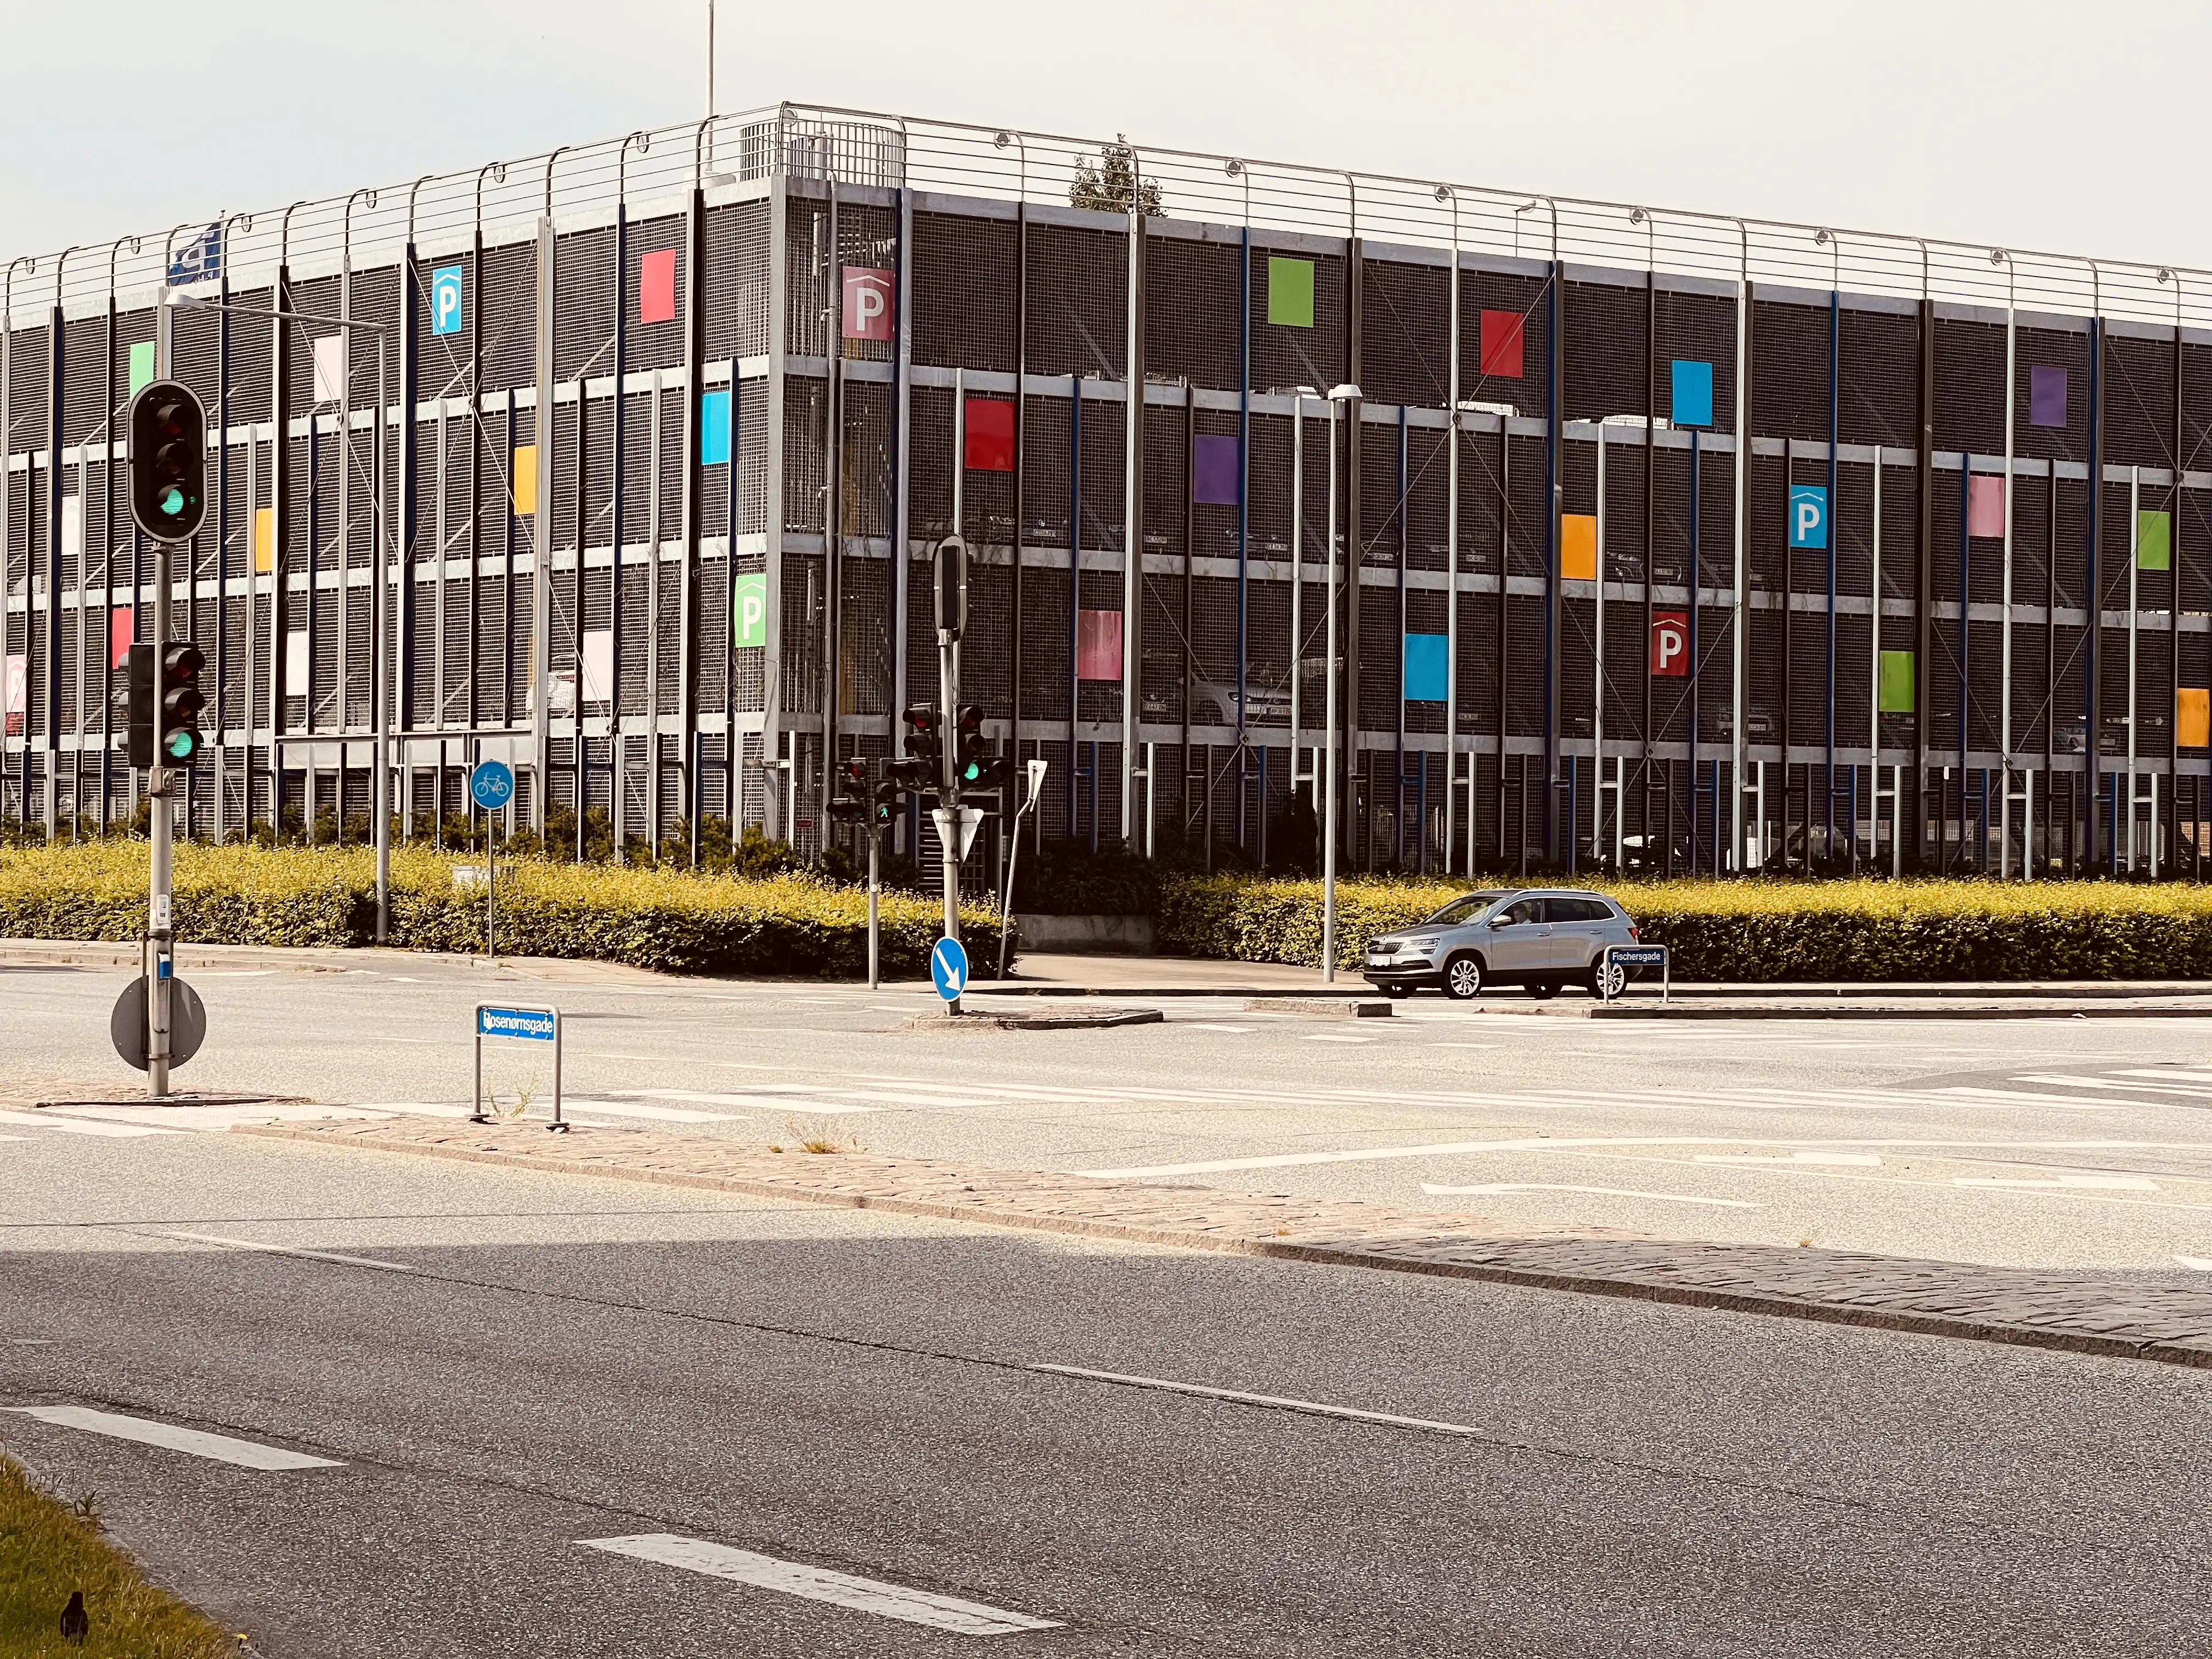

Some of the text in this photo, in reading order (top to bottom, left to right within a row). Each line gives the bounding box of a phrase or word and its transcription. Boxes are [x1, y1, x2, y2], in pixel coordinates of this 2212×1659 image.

[439, 286, 456, 327] P
[856, 287, 884, 331] P
[1798, 503, 1820, 540] P
[743, 596, 762, 640] P
[1660, 630, 1682, 668] P
[1612, 951, 1661, 962] Fischersgade
[483, 1012, 553, 1035] Rosenørnsgade
